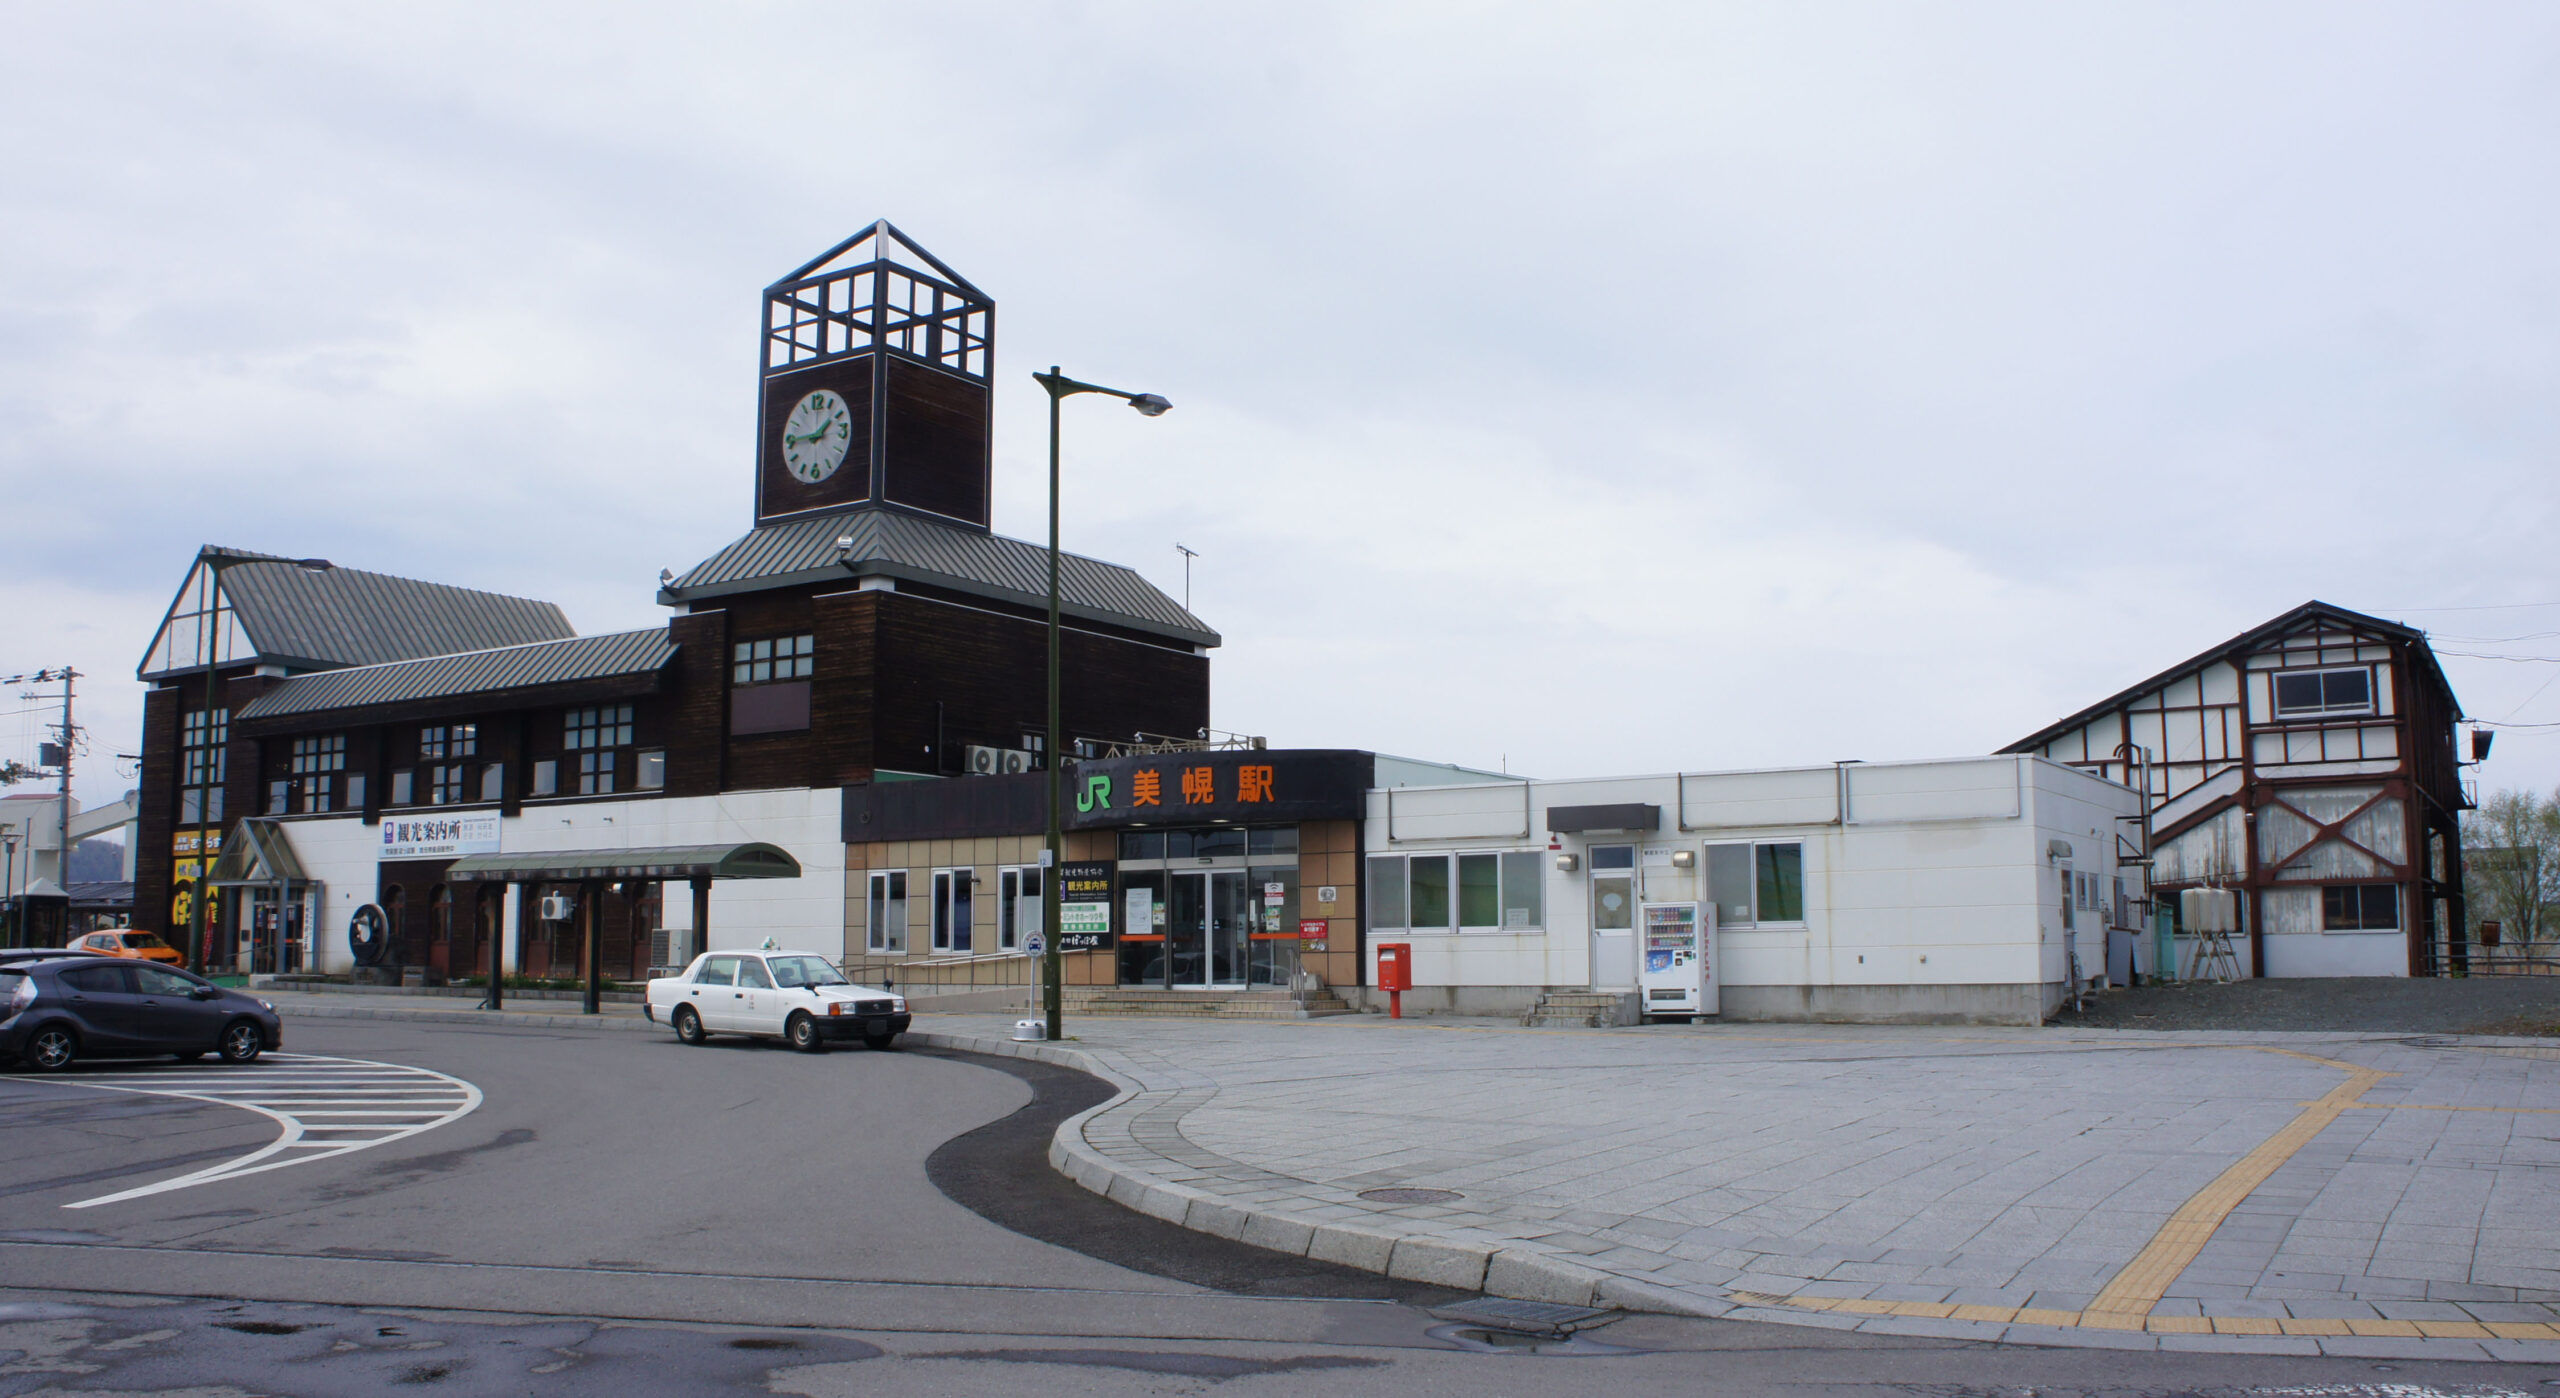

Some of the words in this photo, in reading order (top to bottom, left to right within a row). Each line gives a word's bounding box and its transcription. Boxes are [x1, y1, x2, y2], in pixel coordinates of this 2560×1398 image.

[812, 394, 824, 410] 12
[839, 422, 848, 439] 3
[785, 434, 796, 450] 9
[810, 463, 820, 480] 6
[1077, 775, 1111, 812] JR
[1133, 765, 1275, 807] 美幌駅
[398, 820, 462, 843] 観光案内所
[1067, 880, 1108, 891] 観光案内所
